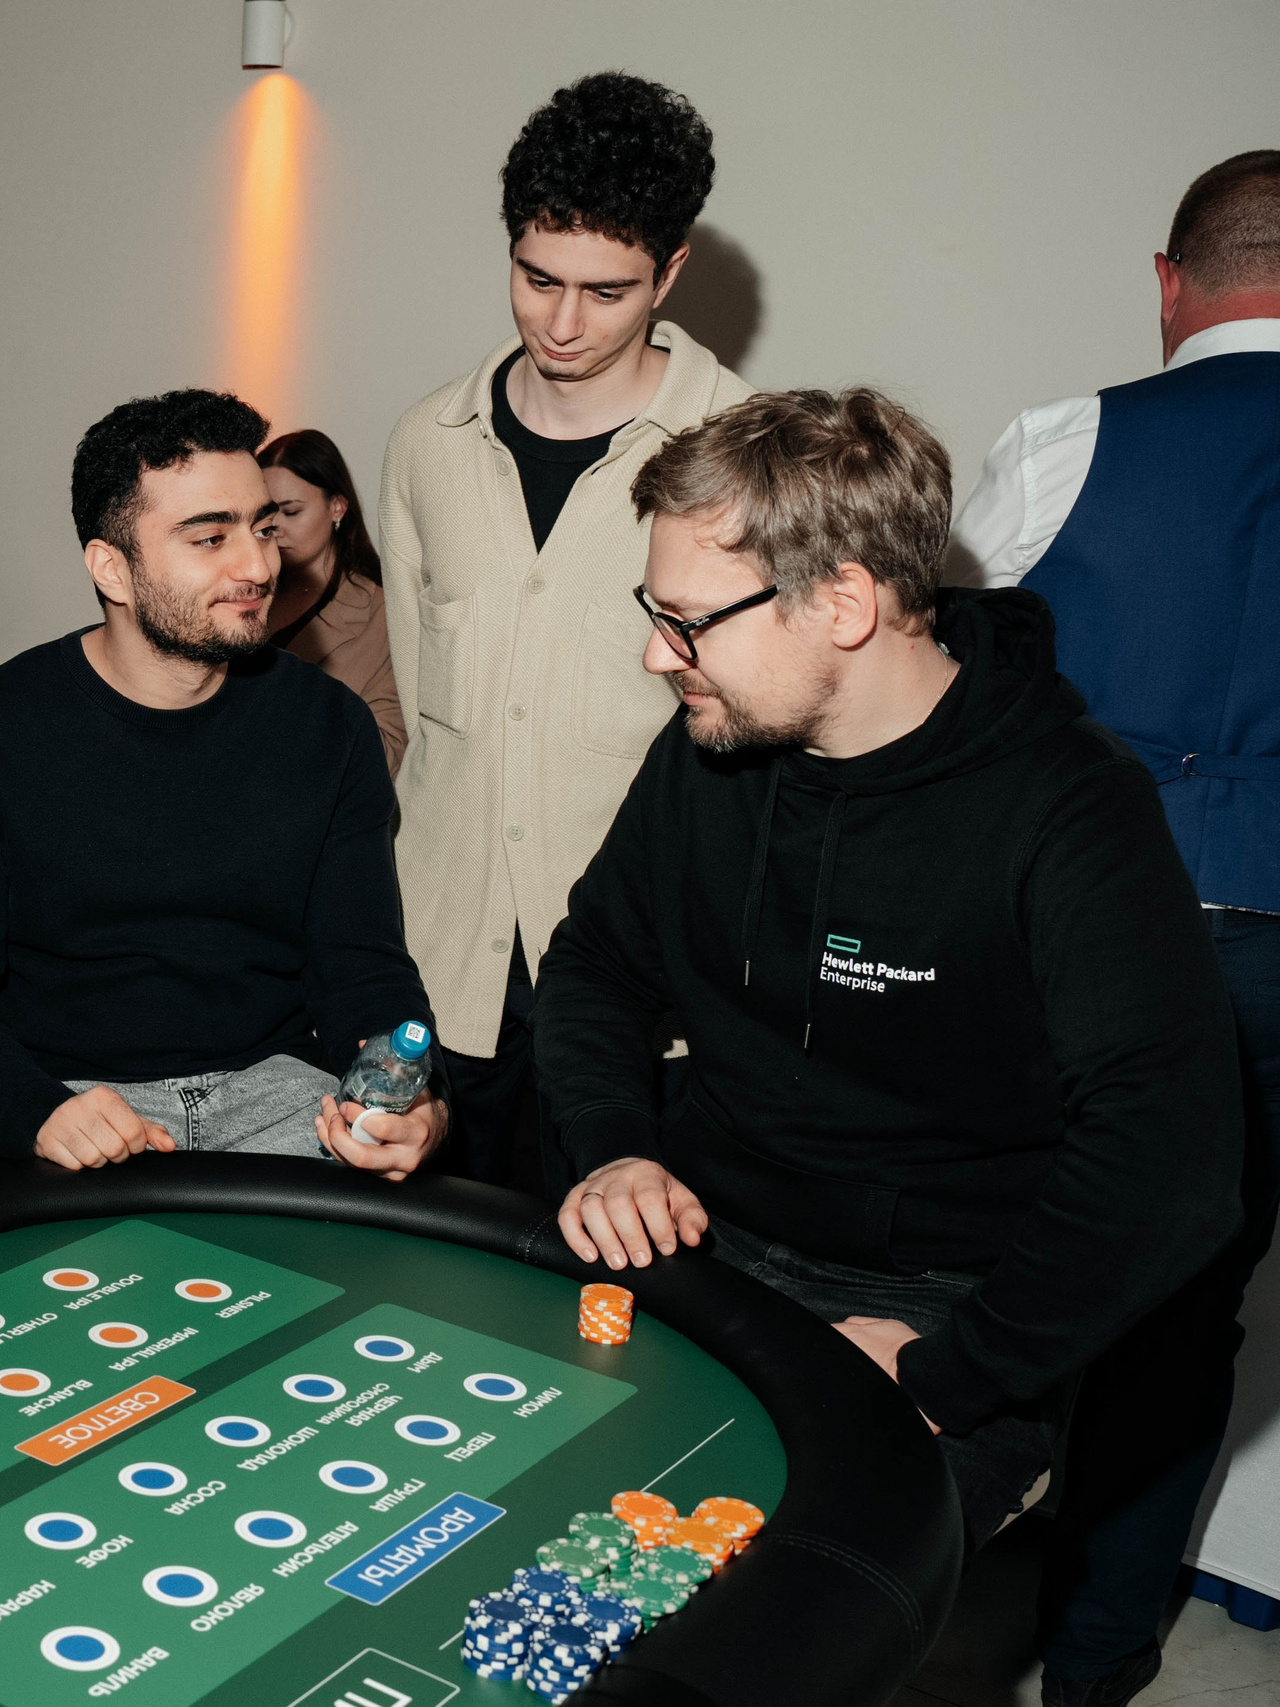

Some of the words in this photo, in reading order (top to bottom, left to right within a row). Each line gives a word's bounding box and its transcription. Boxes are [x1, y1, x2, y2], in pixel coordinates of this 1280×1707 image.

[820, 966, 886, 993] Enterprise
[821, 951, 874, 975] Hewlett
[876, 963, 935, 982] Packard
[63, 1296, 93, 1310] IPA
[86, 1273, 144, 1301] DOUBLE
[215, 1290, 272, 1319] PILSNER
[7, 1312, 58, 1336] OTHER
[131, 1326, 199, 1358] IMPERIAL
[108, 1356, 140, 1371] IPA
[407, 1351, 443, 1374] ДЫМ
[18, 1379, 93, 1417] BLANCHE
[315, 1382, 390, 1426] СМОРОДИНА
[344, 1395, 403, 1427] ЧЕРНАЯ
[513, 1386, 563, 1418] ЛИМОН
[48, 1391, 160, 1449] СВЕТЛОЕ
[236, 1426, 320, 1471] ШОКОЛАД
[444, 1431, 496, 1462] ПЕРЕЦ
[163, 1480, 227, 1516] СОСНА
[369, 1478, 426, 1513] ГРУША
[75, 1534, 134, 1569] КОФЕ
[272, 1520, 359, 1578] АПЕЛЬСИН
[357, 1507, 476, 1587] АРОМАТЫ
[190, 1583, 266, 1633] ЯБЛОКО
[87, 1646, 171, 1697] ВАНИЛЬ
